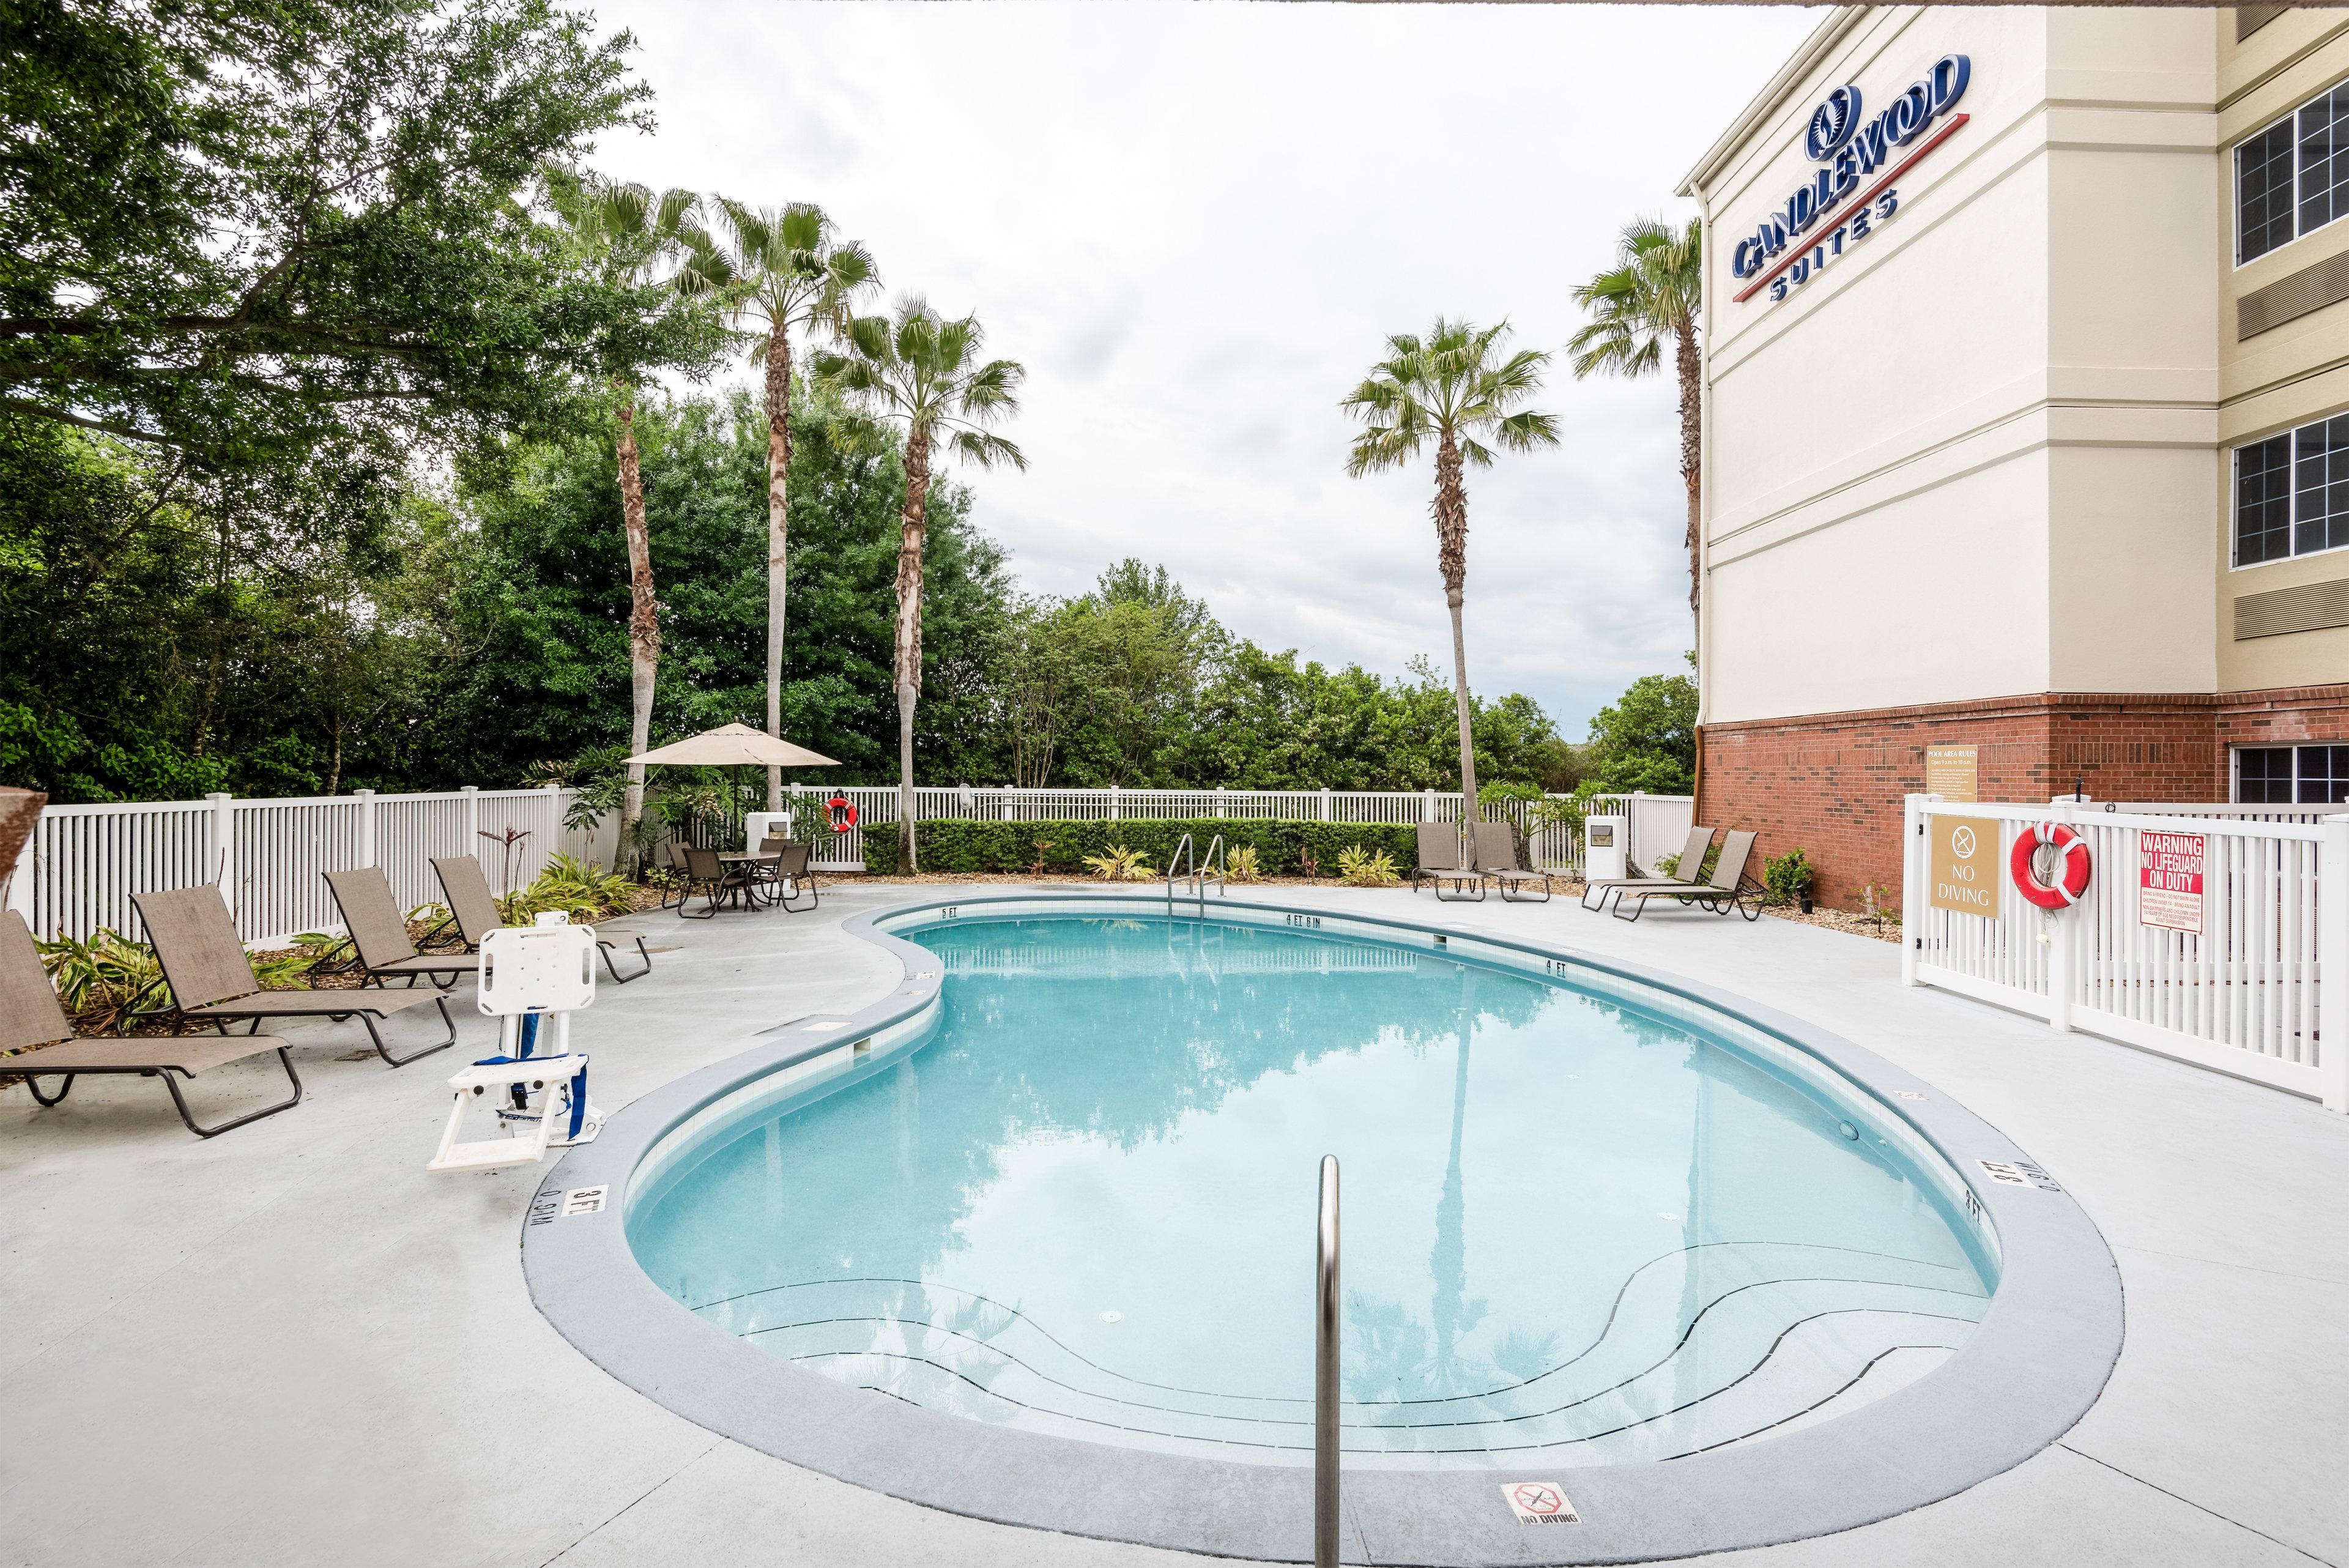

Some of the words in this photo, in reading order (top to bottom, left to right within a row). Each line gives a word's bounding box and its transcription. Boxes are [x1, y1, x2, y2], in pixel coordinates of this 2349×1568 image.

[1732, 54, 1971, 279] CANDLEWOOD
[1770, 189, 1898, 302] SUITES
[2142, 834, 2202, 856] WARNING
[1952, 864, 1975, 882] NO
[2141, 852, 2153, 869] NO
[2155, 852, 2202, 874] LIFEGUARD
[2150, 870, 2163, 888] ON
[2166, 872, 2193, 891] DUTY
[1939, 883, 1989, 906] DIVING
[1557, 962, 1566, 972] FT
[1965, 1189, 1970, 1209] 3
[1972, 1197, 1981, 1225] FT
[1521, 1515, 1538, 1524] NO
[1539, 1514, 1578, 1523] DIVING
